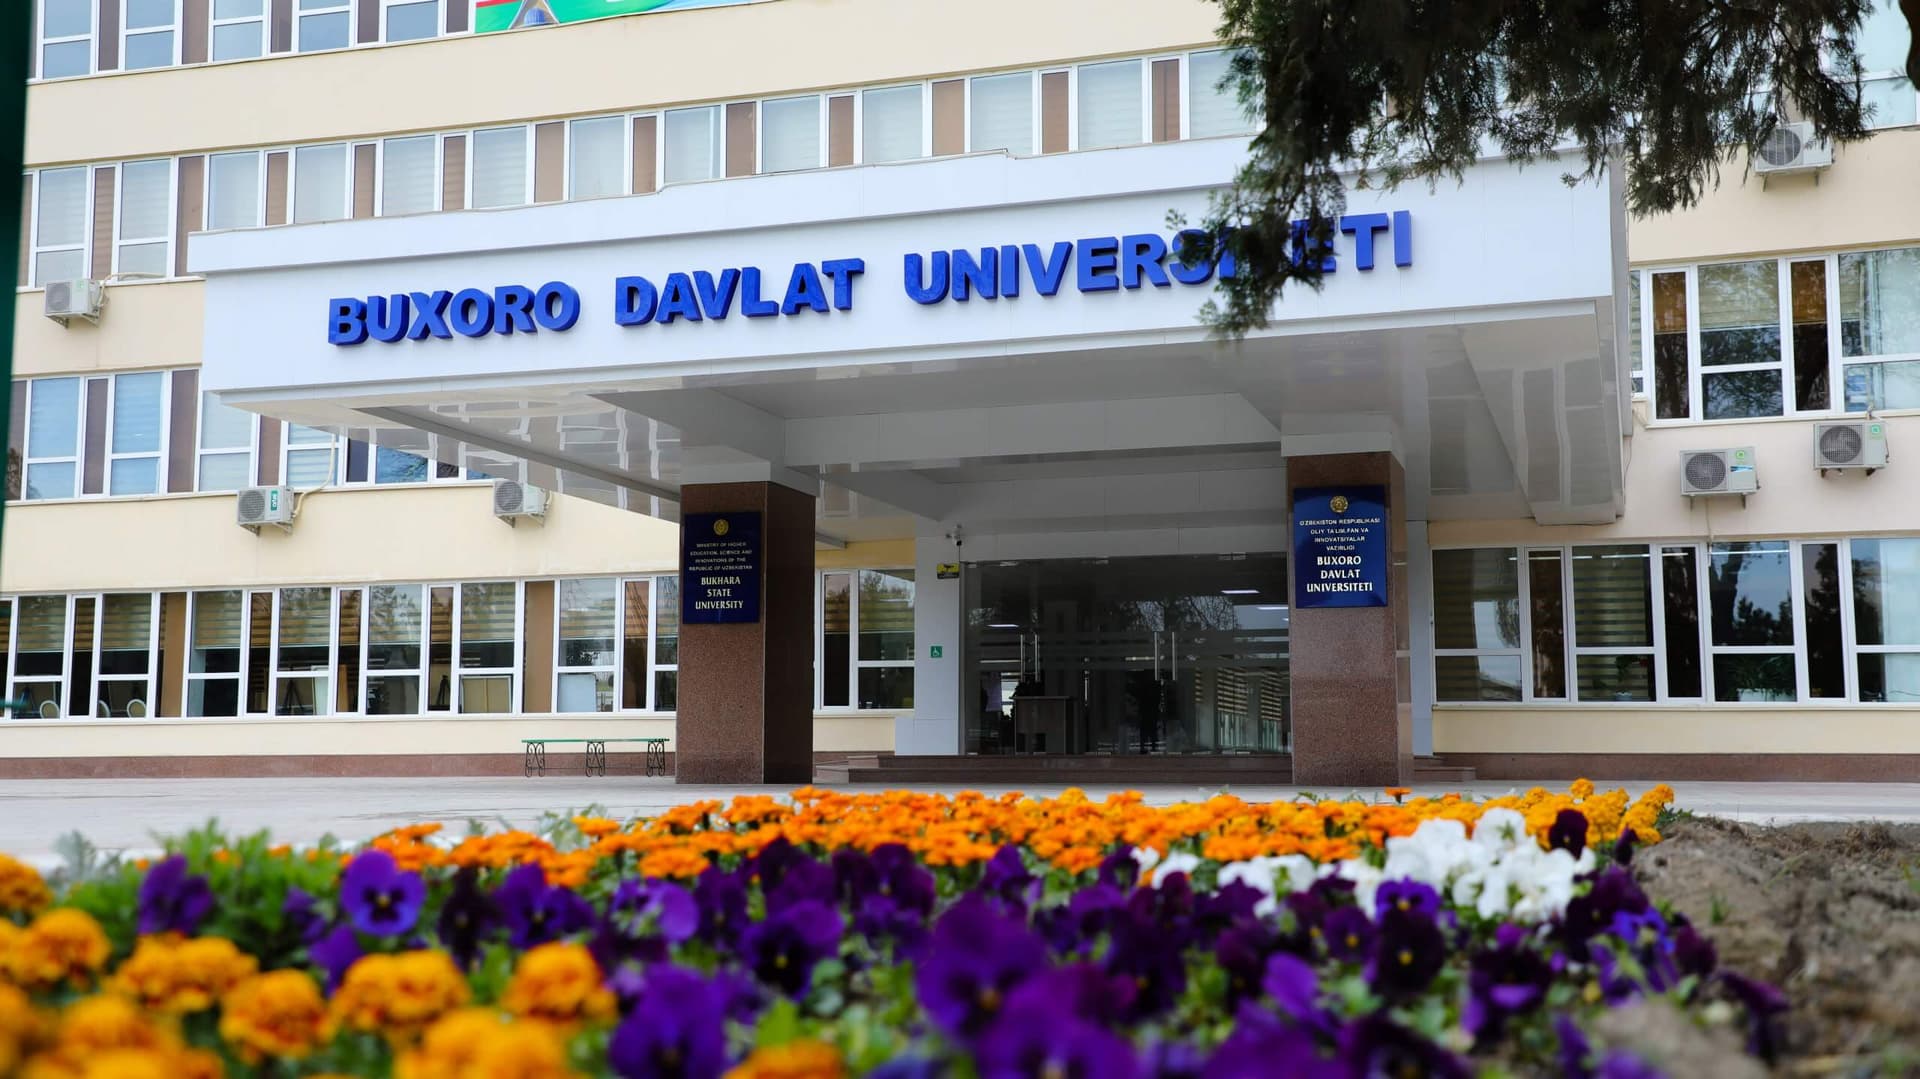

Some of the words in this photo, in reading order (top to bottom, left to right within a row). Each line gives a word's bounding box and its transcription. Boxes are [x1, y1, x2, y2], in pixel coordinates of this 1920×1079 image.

[328, 281, 581, 346] BUXORO
[615, 258, 865, 327] DAVLAT
[1316, 555, 1362, 566] BUXORO
[1320, 569, 1361, 579] DAVLAT
[701, 576, 741, 586] BUKHARA
[1306, 582, 1373, 593] UNIVERSITETI
[706, 588, 732, 598] STATE
[695, 600, 744, 610] UNIVERSITY
